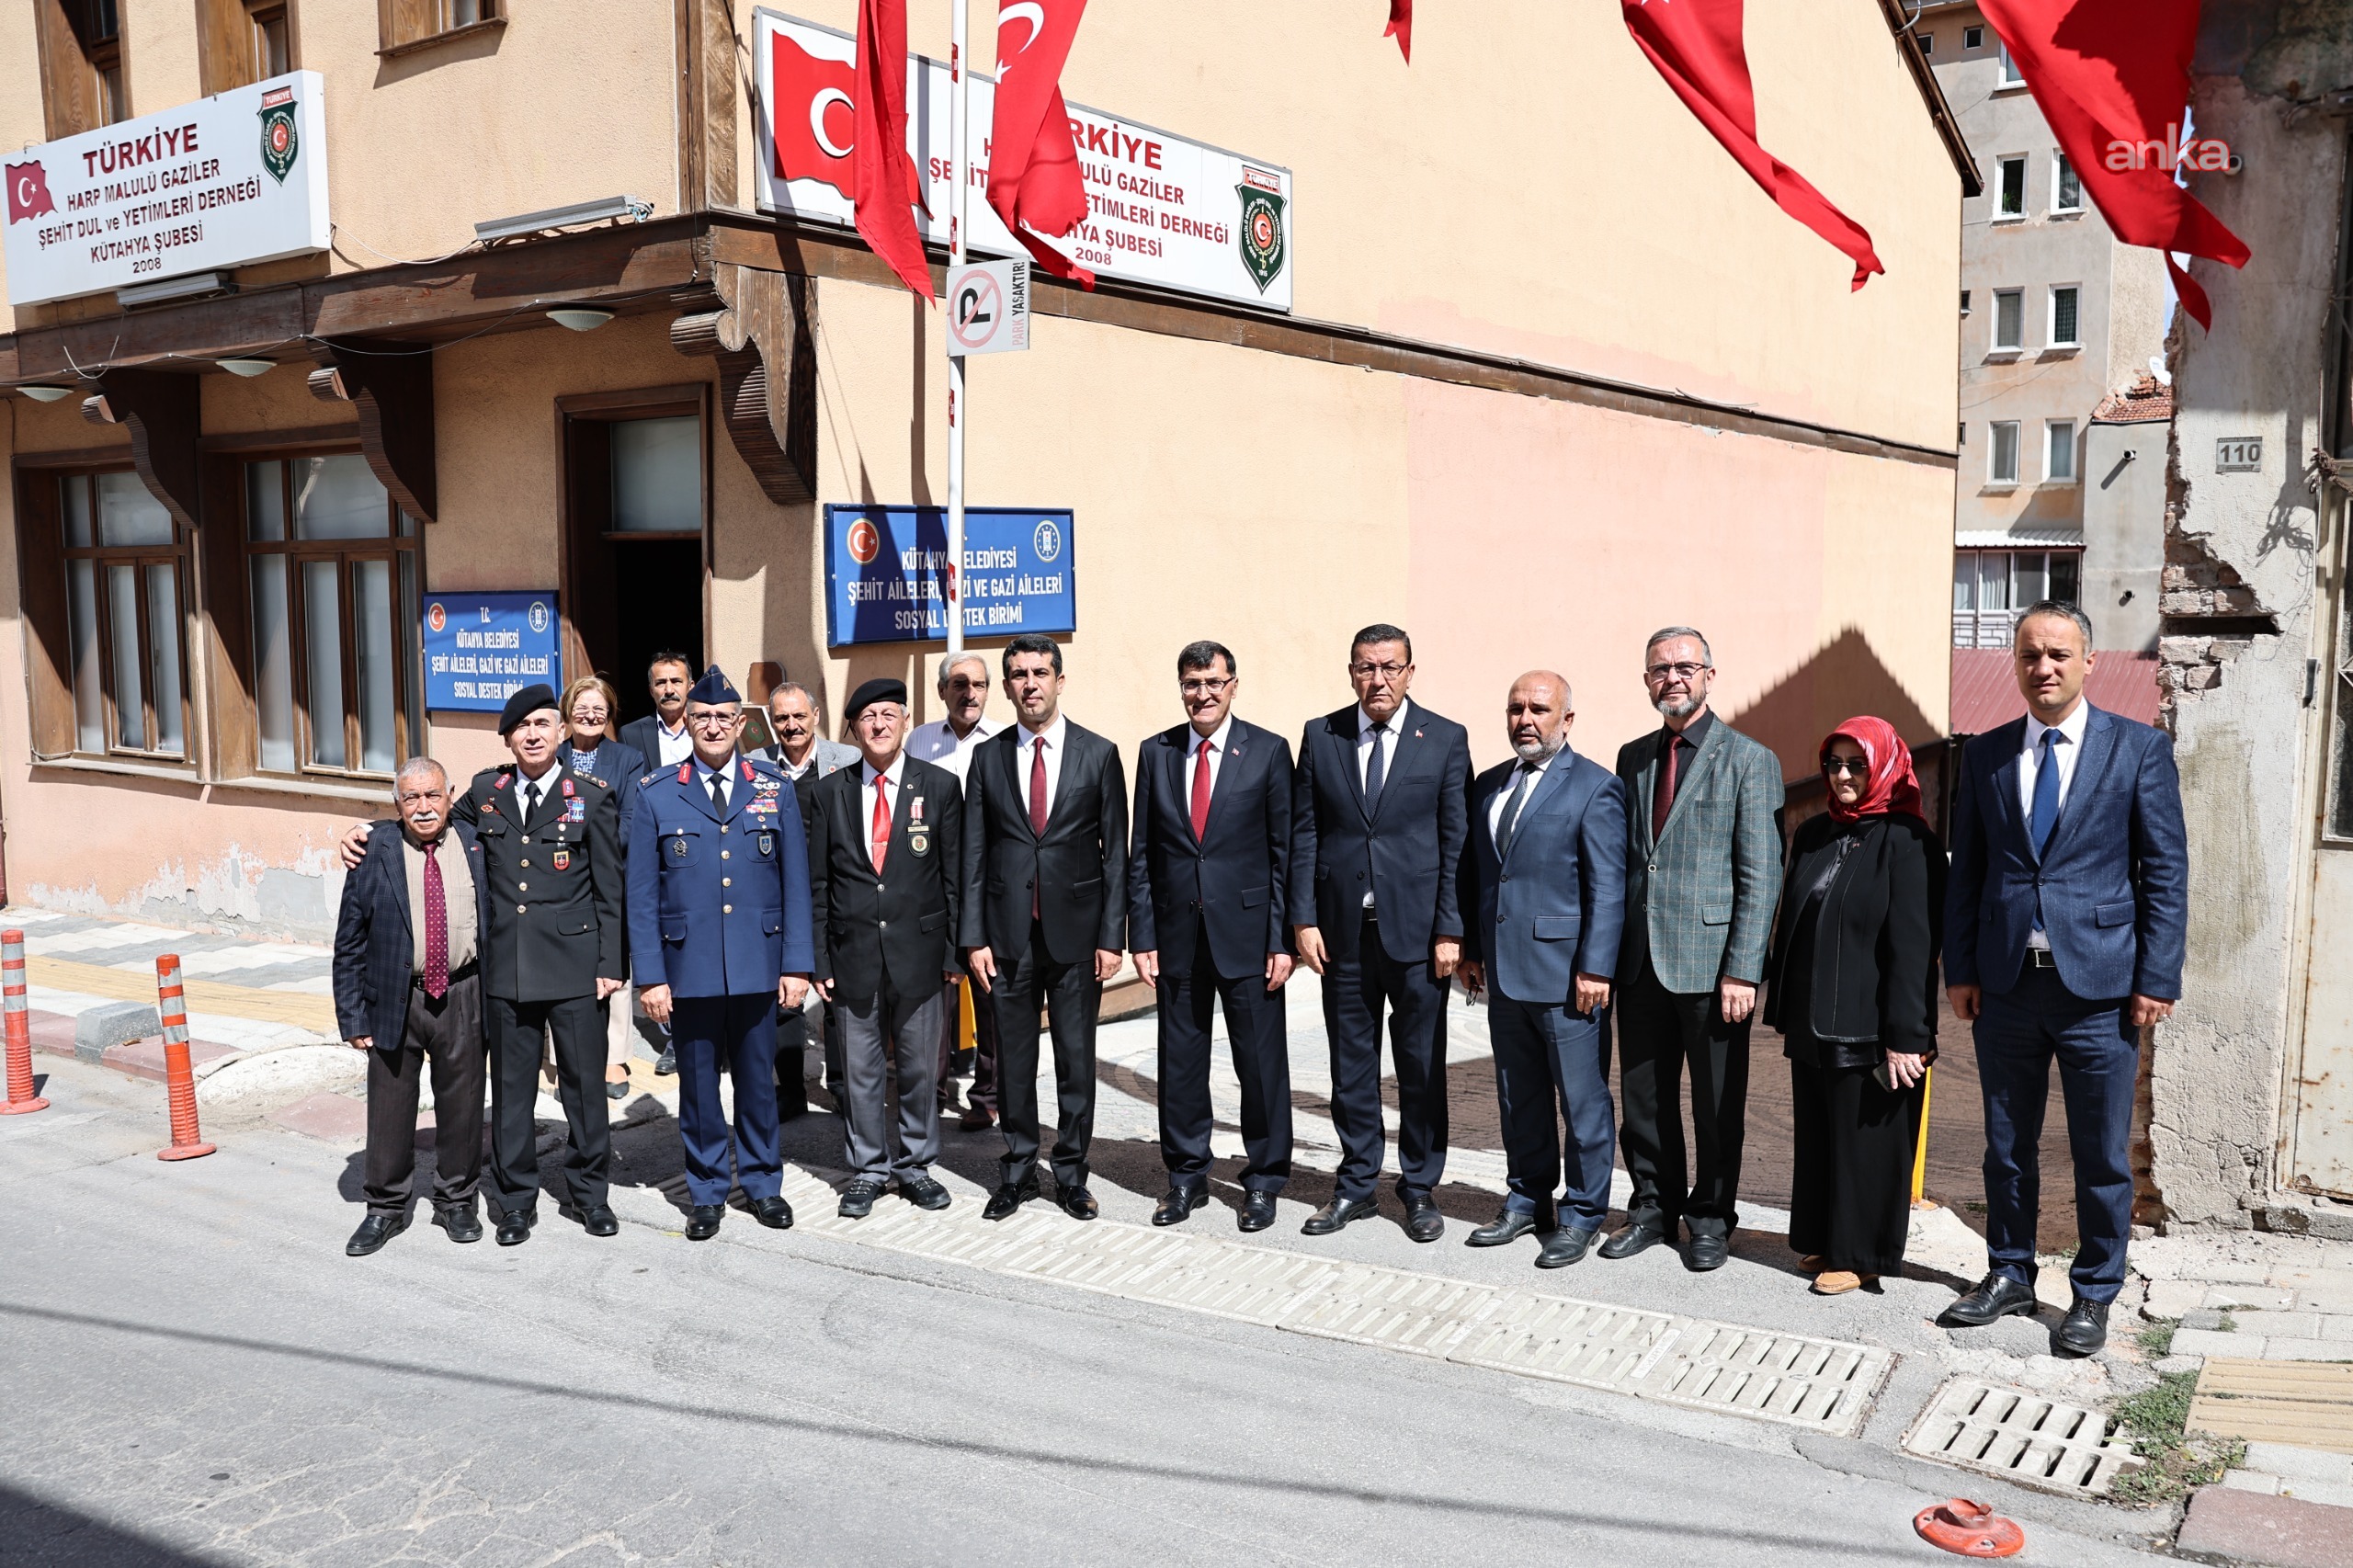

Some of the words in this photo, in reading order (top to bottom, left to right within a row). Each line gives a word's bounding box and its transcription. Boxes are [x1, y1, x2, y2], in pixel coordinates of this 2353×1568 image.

[83, 123, 199, 177] TÜRKİYE
[1067, 117, 1162, 171] RKİYE
[67, 188, 100, 212] HARP
[105, 171, 156, 203] MALULÜ
[161, 158, 221, 189] GAZİLER
[929, 157, 989, 188] ŞEİT
[1080, 161, 1112, 187] ULÜ
[1117, 172, 1185, 205] GAZİLER
[39, 219, 74, 250] ŞEHİT
[78, 217, 102, 238] DUL
[106, 216, 119, 232] ve
[123, 190, 194, 227] YETİMLERİ
[198, 174, 261, 210] DERNEĞİ
[1085, 192, 1154, 227] ETİMLERİ
[1160, 211, 1229, 245] DERNEĞİ
[90, 235, 151, 264] KÜTAHYA
[154, 220, 203, 255] ŞUBESİ
[1075, 246, 1111, 266] 2008
[1105, 229, 1163, 258] ŞUBESİ
[132, 256, 162, 274] 2008
[1012, 261, 1025, 316] YASAKTIR!
[1012, 318, 1024, 346] PARK
[2220, 444, 2261, 462] 110
[964, 546, 1017, 569] ELEDİYESİ
[847, 577, 884, 607] ŞEHİT
[887, 576, 943, 603] AİLELERİ,
[973, 578, 988, 597] VE
[991, 574, 1015, 597] GAZİ
[1017, 572, 1063, 596] AİLELERİ
[480, 607, 491, 623] T.C.
[894, 609, 940, 630] SOSYAL
[988, 601, 1023, 625] BİRİMİ
[457, 629, 483, 649] KÜTAHYA
[484, 629, 519, 649] BELEDİYESİ
[432, 653, 449, 676] ŞEHİT
[450, 653, 478, 676] AİLELERİ,
[479, 653, 494, 674] GAZİ
[494, 657, 503, 674] VE
[504, 653, 518, 675] GAZİ
[519, 653, 549, 675] AİLELERİ
[454, 681, 477, 699] SOSYAL
[478, 682, 502, 699] DESTEK
